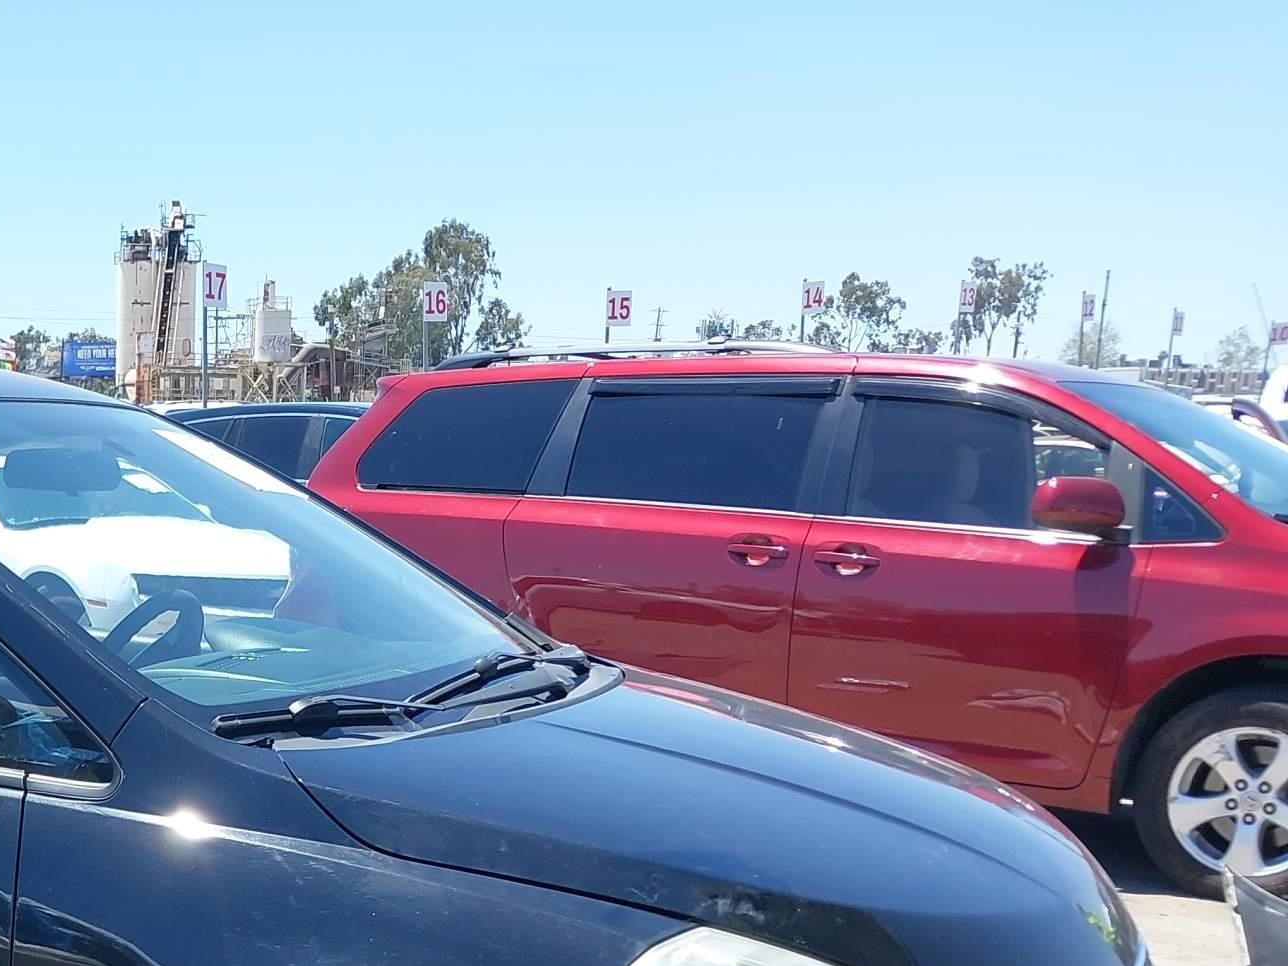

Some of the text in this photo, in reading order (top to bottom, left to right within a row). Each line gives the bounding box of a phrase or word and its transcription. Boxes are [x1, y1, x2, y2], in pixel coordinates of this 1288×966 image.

[204, 271, 227, 301] 17
[961, 286, 976, 308] 13
[424, 290, 448, 315] 16
[607, 296, 632, 321] 15
[803, 287, 824, 310] 14
[1082, 299, 1096, 317] 12
[92, 348, 108, 359] YOUR
